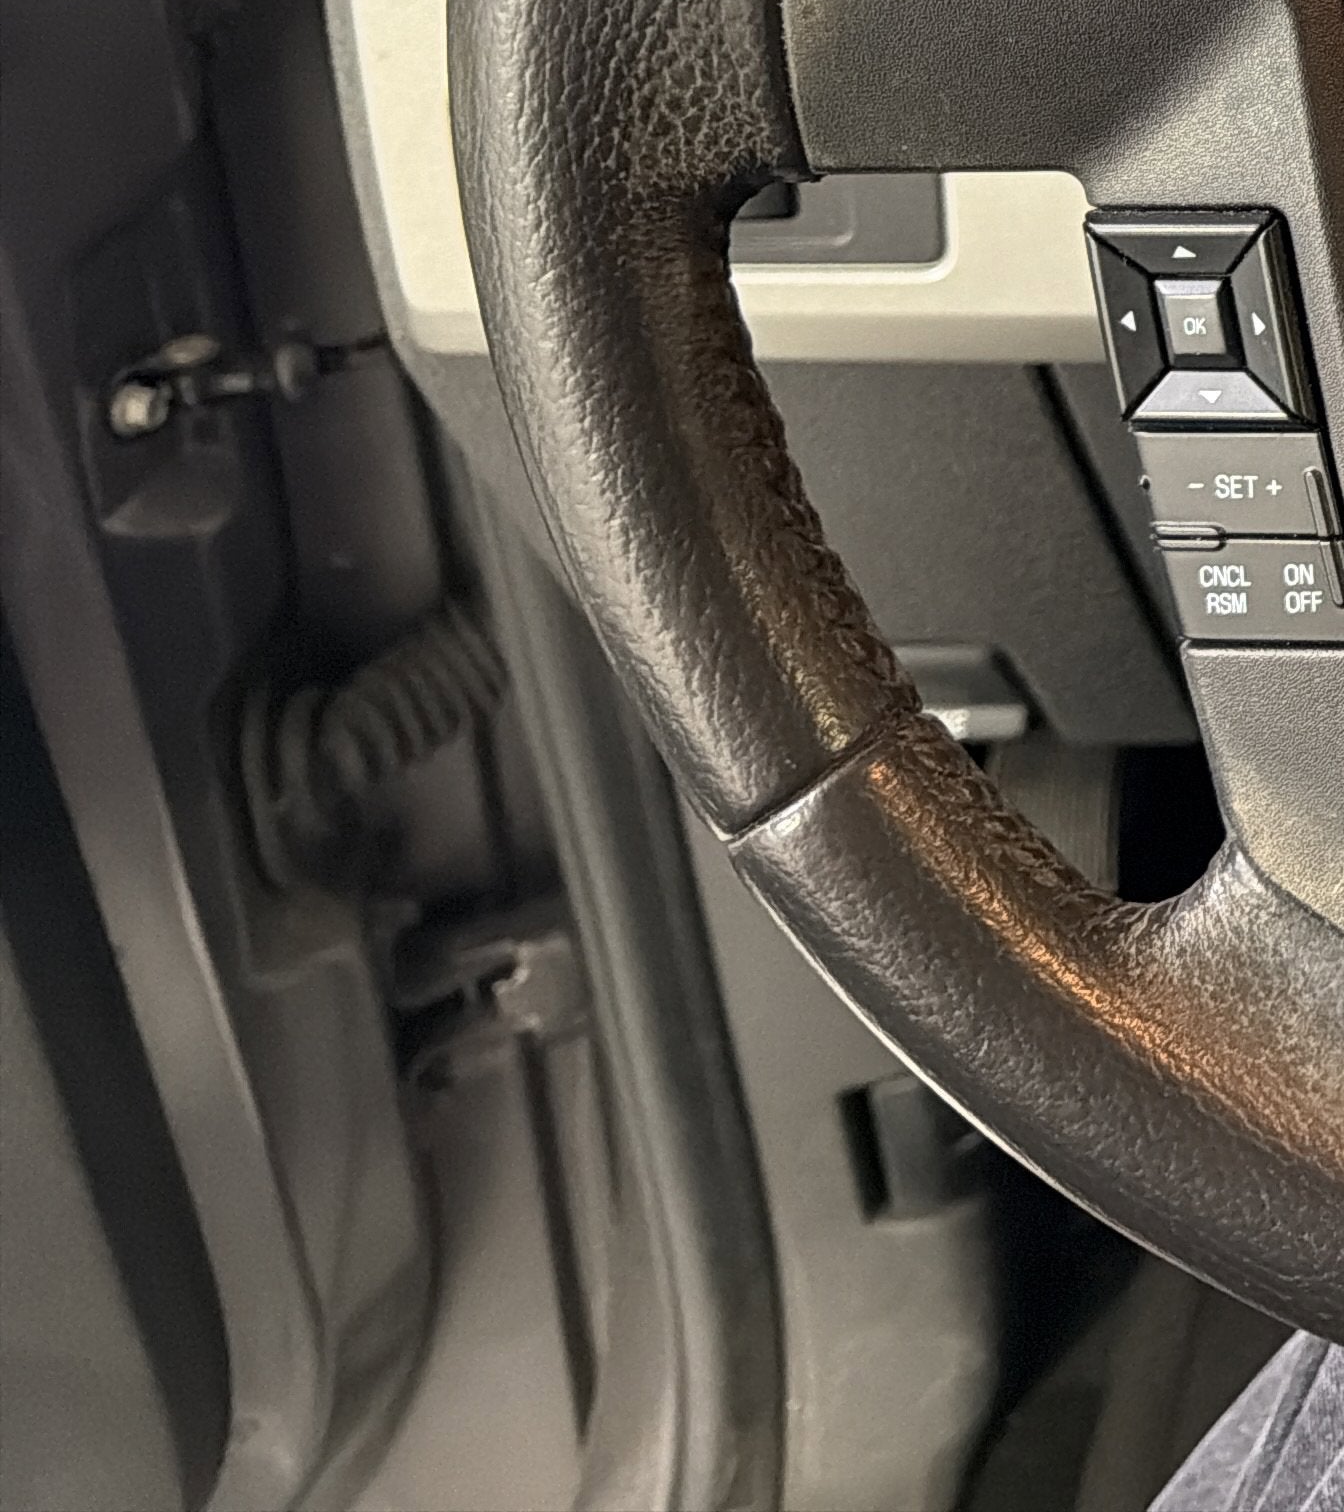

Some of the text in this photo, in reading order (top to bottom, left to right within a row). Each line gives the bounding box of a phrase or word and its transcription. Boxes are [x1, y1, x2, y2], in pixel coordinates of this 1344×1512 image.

[1183, 317, 1206, 334] OK
[1214, 475, 1258, 499] SET
[1199, 564, 1315, 587] CNCL ON
[1206, 591, 1322, 614] RSM OFF
